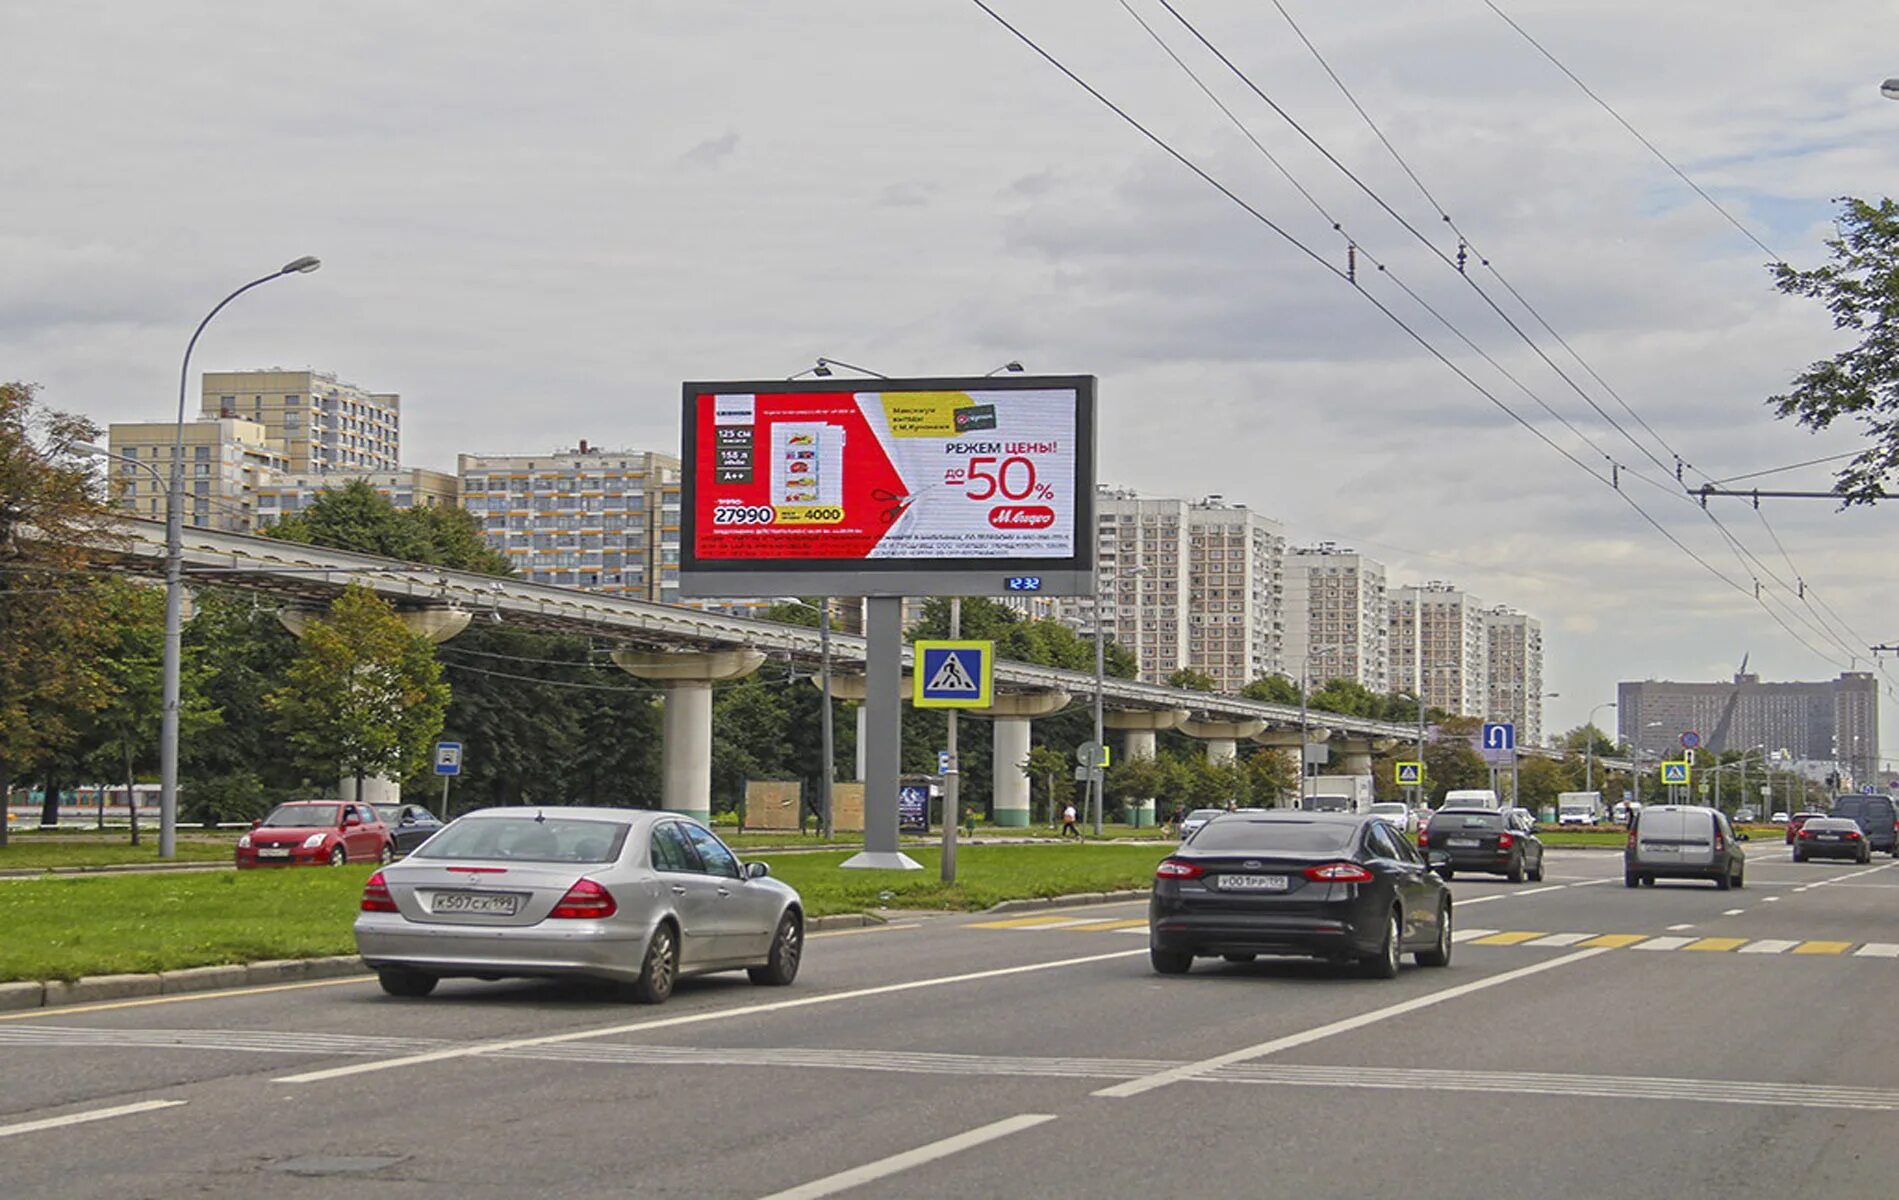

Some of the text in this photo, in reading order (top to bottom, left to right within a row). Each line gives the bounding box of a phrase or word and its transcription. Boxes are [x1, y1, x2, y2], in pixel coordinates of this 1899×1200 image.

[945, 441, 1057, 455] РЕЖЕМ ЦЕНЫ!
[715, 508, 771, 523] 27990
[804, 509, 841, 520] 4000
